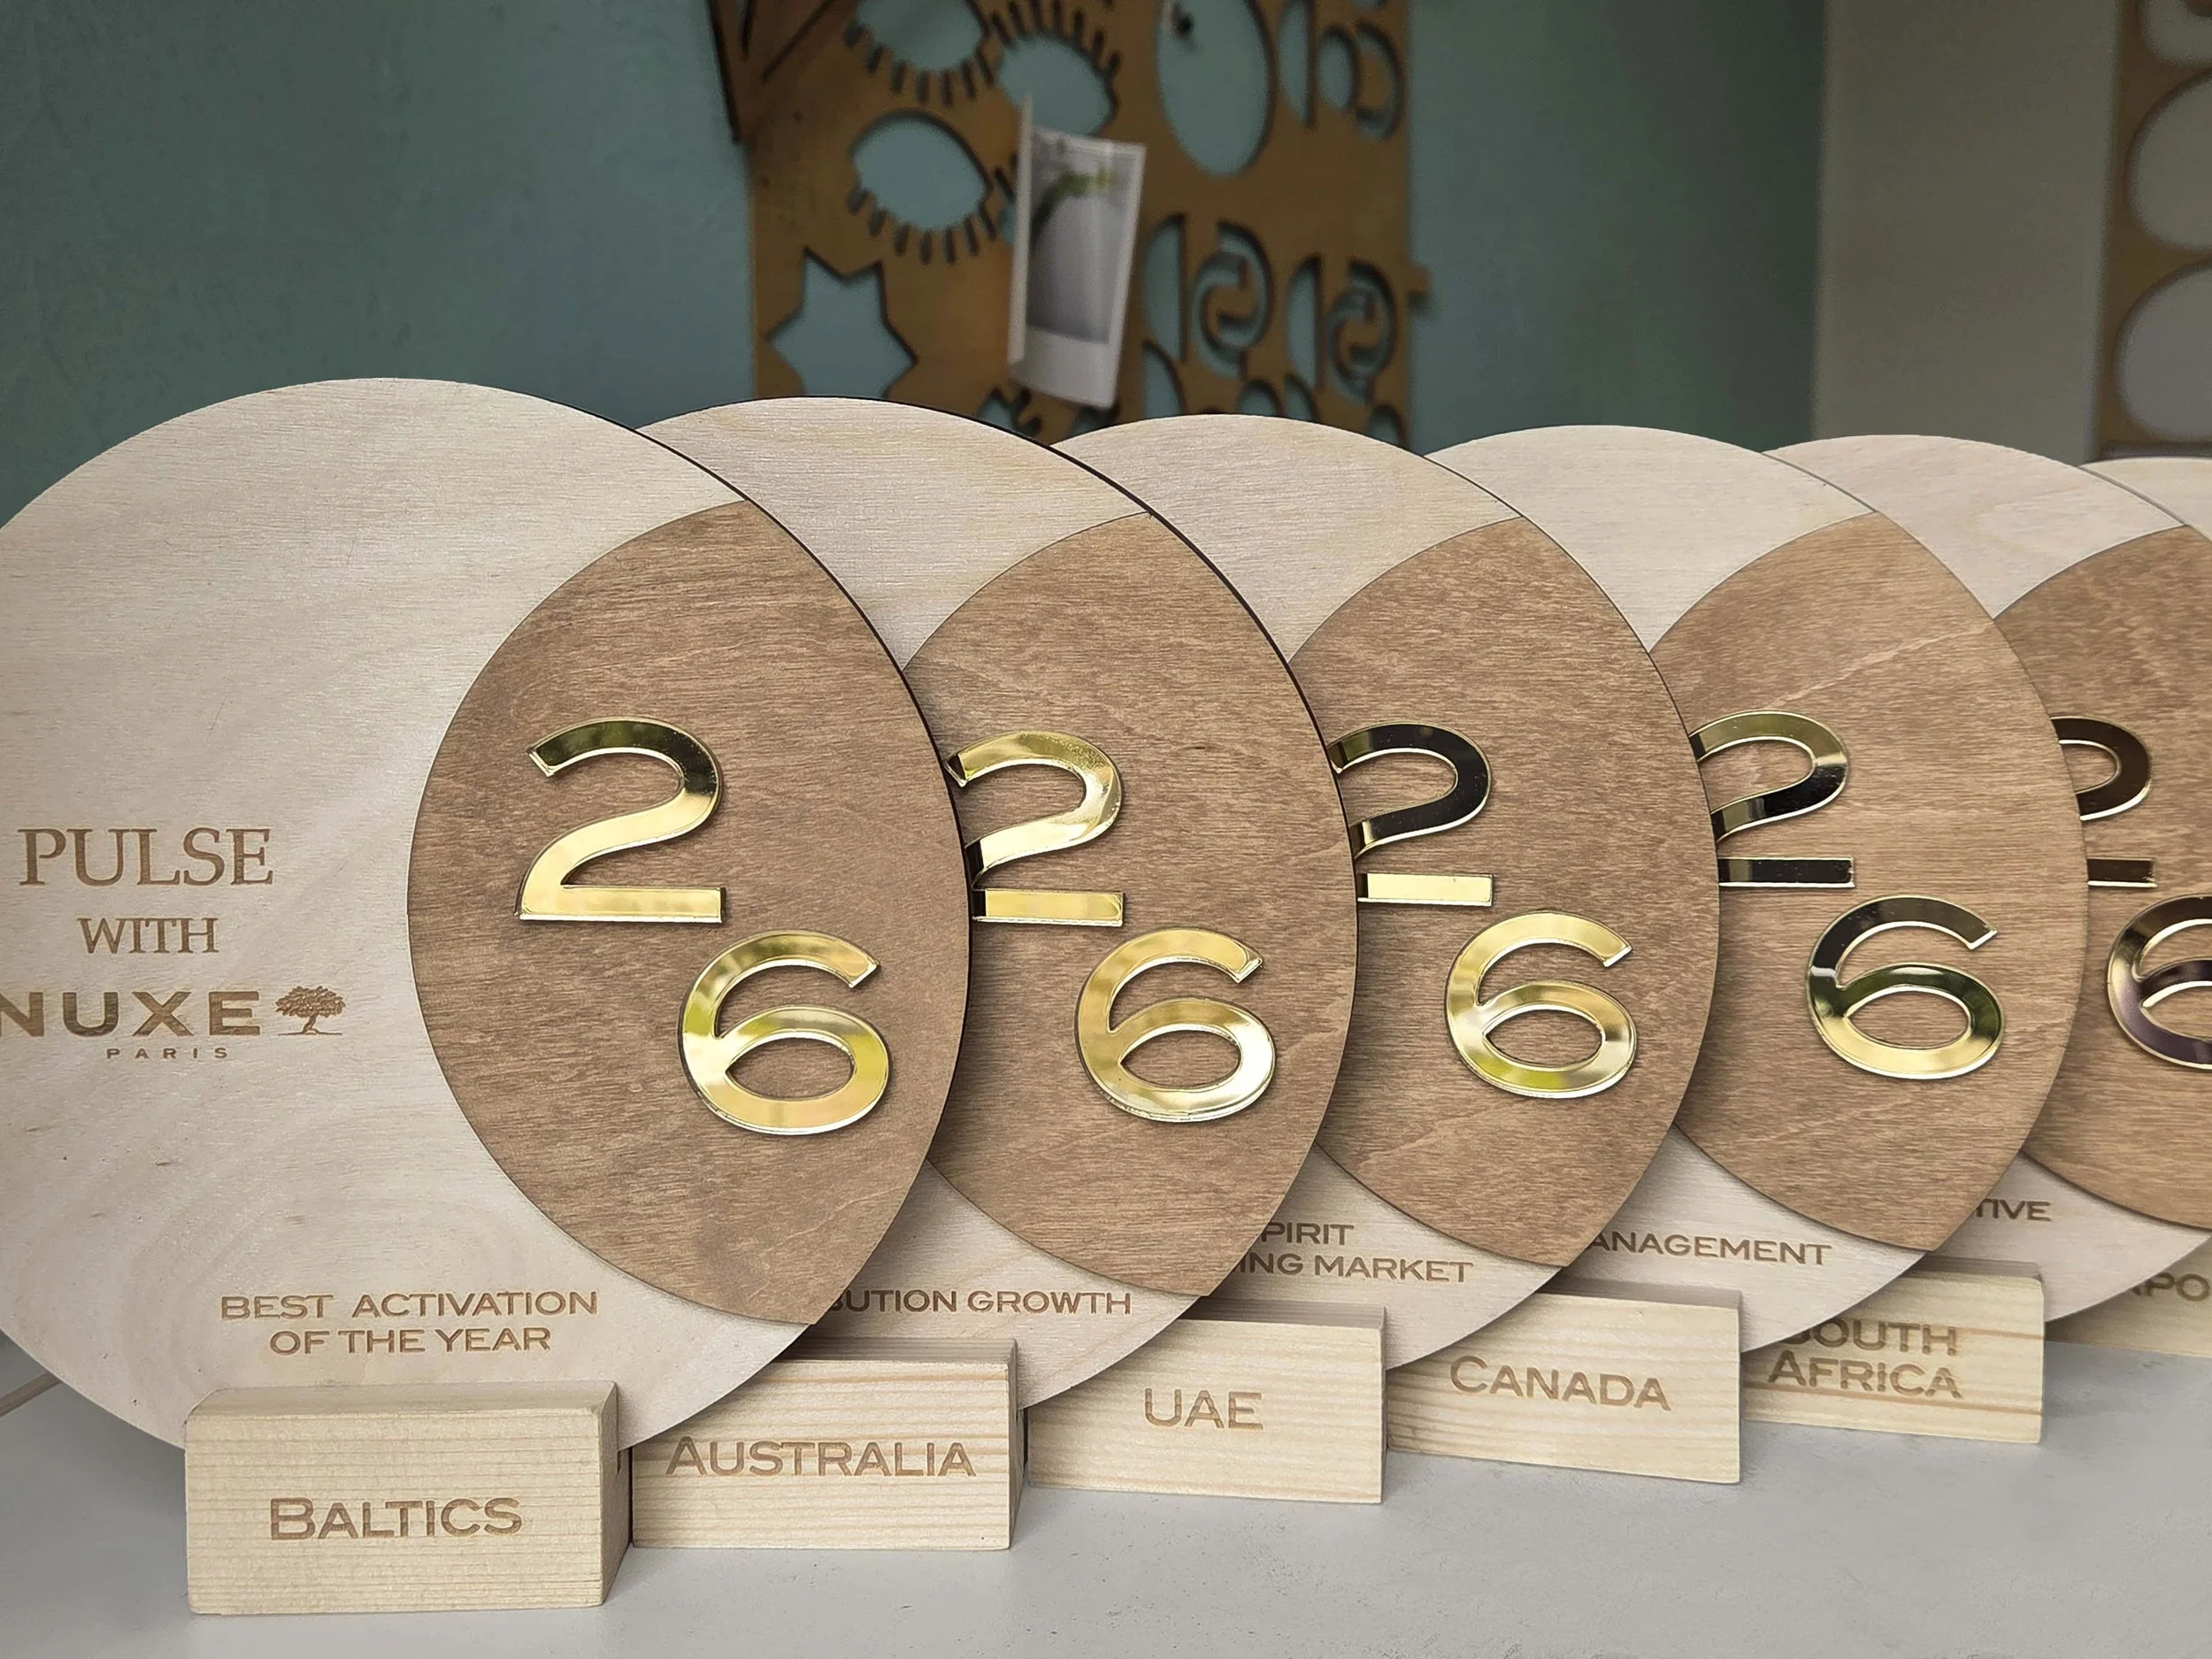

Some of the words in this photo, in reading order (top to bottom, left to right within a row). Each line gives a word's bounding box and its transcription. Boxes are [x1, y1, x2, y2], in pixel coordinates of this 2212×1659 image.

[514, 716, 726, 923] 2
[1327, 721, 1494, 907] 2
[1688, 710, 1855, 888] 2
[942, 730, 1125, 927] 2
[17, 827, 273, 886] PULSE
[77, 918, 219, 954] WITH
[1444, 909, 1637, 1099] 6
[1807, 895, 2006, 1079] 6
[0, 991, 260, 1038] NUXE
[678, 929, 893, 1136] 6
[1074, 926, 1277, 1123] 6
[106, 1047, 229, 1059] PARIS
[1235, 1252, 1303, 1275] ING
[1314, 1255, 1474, 1283] MARKET
[220, 1294, 334, 1320] BEST
[352, 1291, 598, 1317] ACTIVATION
[967, 1289, 1131, 1315] GROWTH
[269, 1330, 327, 1355] OF
[338, 1329, 426, 1354] THE
[435, 1326, 552, 1353] YEAR
[1450, 1356, 1671, 1411] CANADA
[1767, 1349, 1962, 1399] AFRICA
[1144, 1387, 1264, 1431] UAE
[664, 1435, 977, 1478] AUSTRALIA
[270, 1497, 523, 1540] BALTICS
